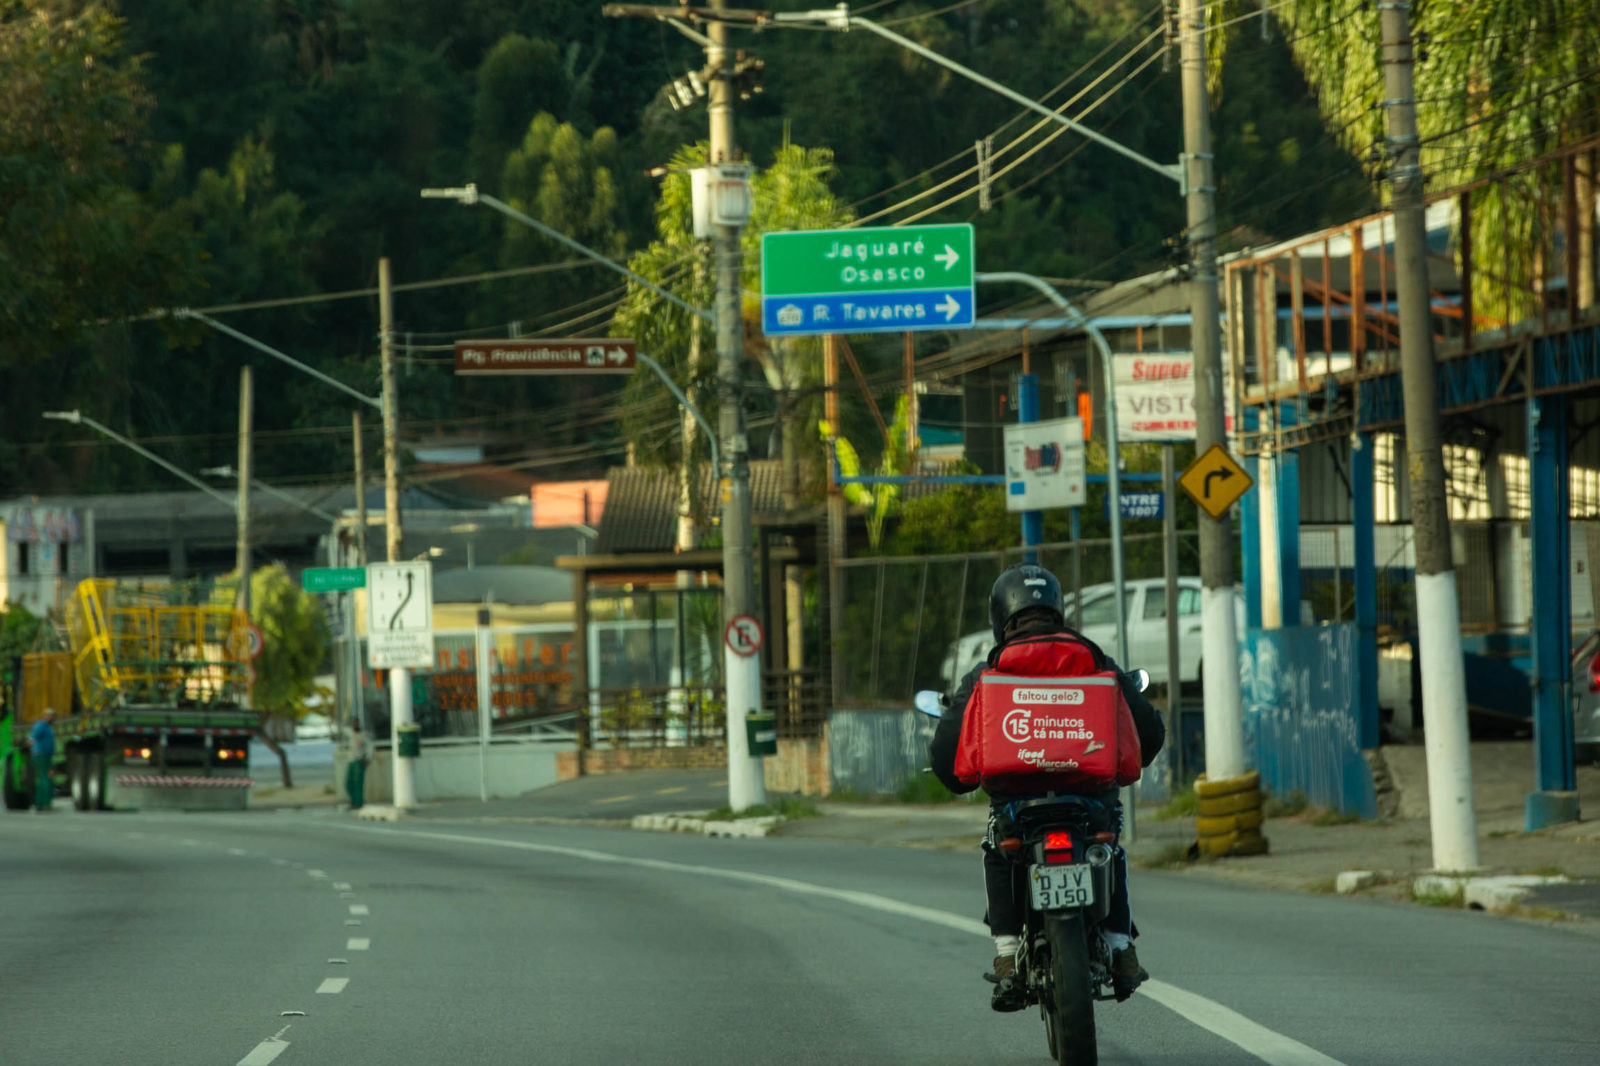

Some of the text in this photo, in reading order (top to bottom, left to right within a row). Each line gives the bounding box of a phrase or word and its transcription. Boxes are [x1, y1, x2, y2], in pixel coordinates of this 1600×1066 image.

[825, 236, 925, 260] Jaguaré
[841, 266, 926, 283] Osasco
[842, 302, 926, 320] Tavares
[1132, 359, 1192, 381] Super
[1018, 691, 1079, 703] faltou gelo?
[1009, 719, 1029, 735] 15
[1033, 715, 1084, 727] minutos
[1033, 728, 1094, 740] tá na mão
[1036, 759, 1079, 769] Mercado
[1040, 889, 1086, 906] 3150
